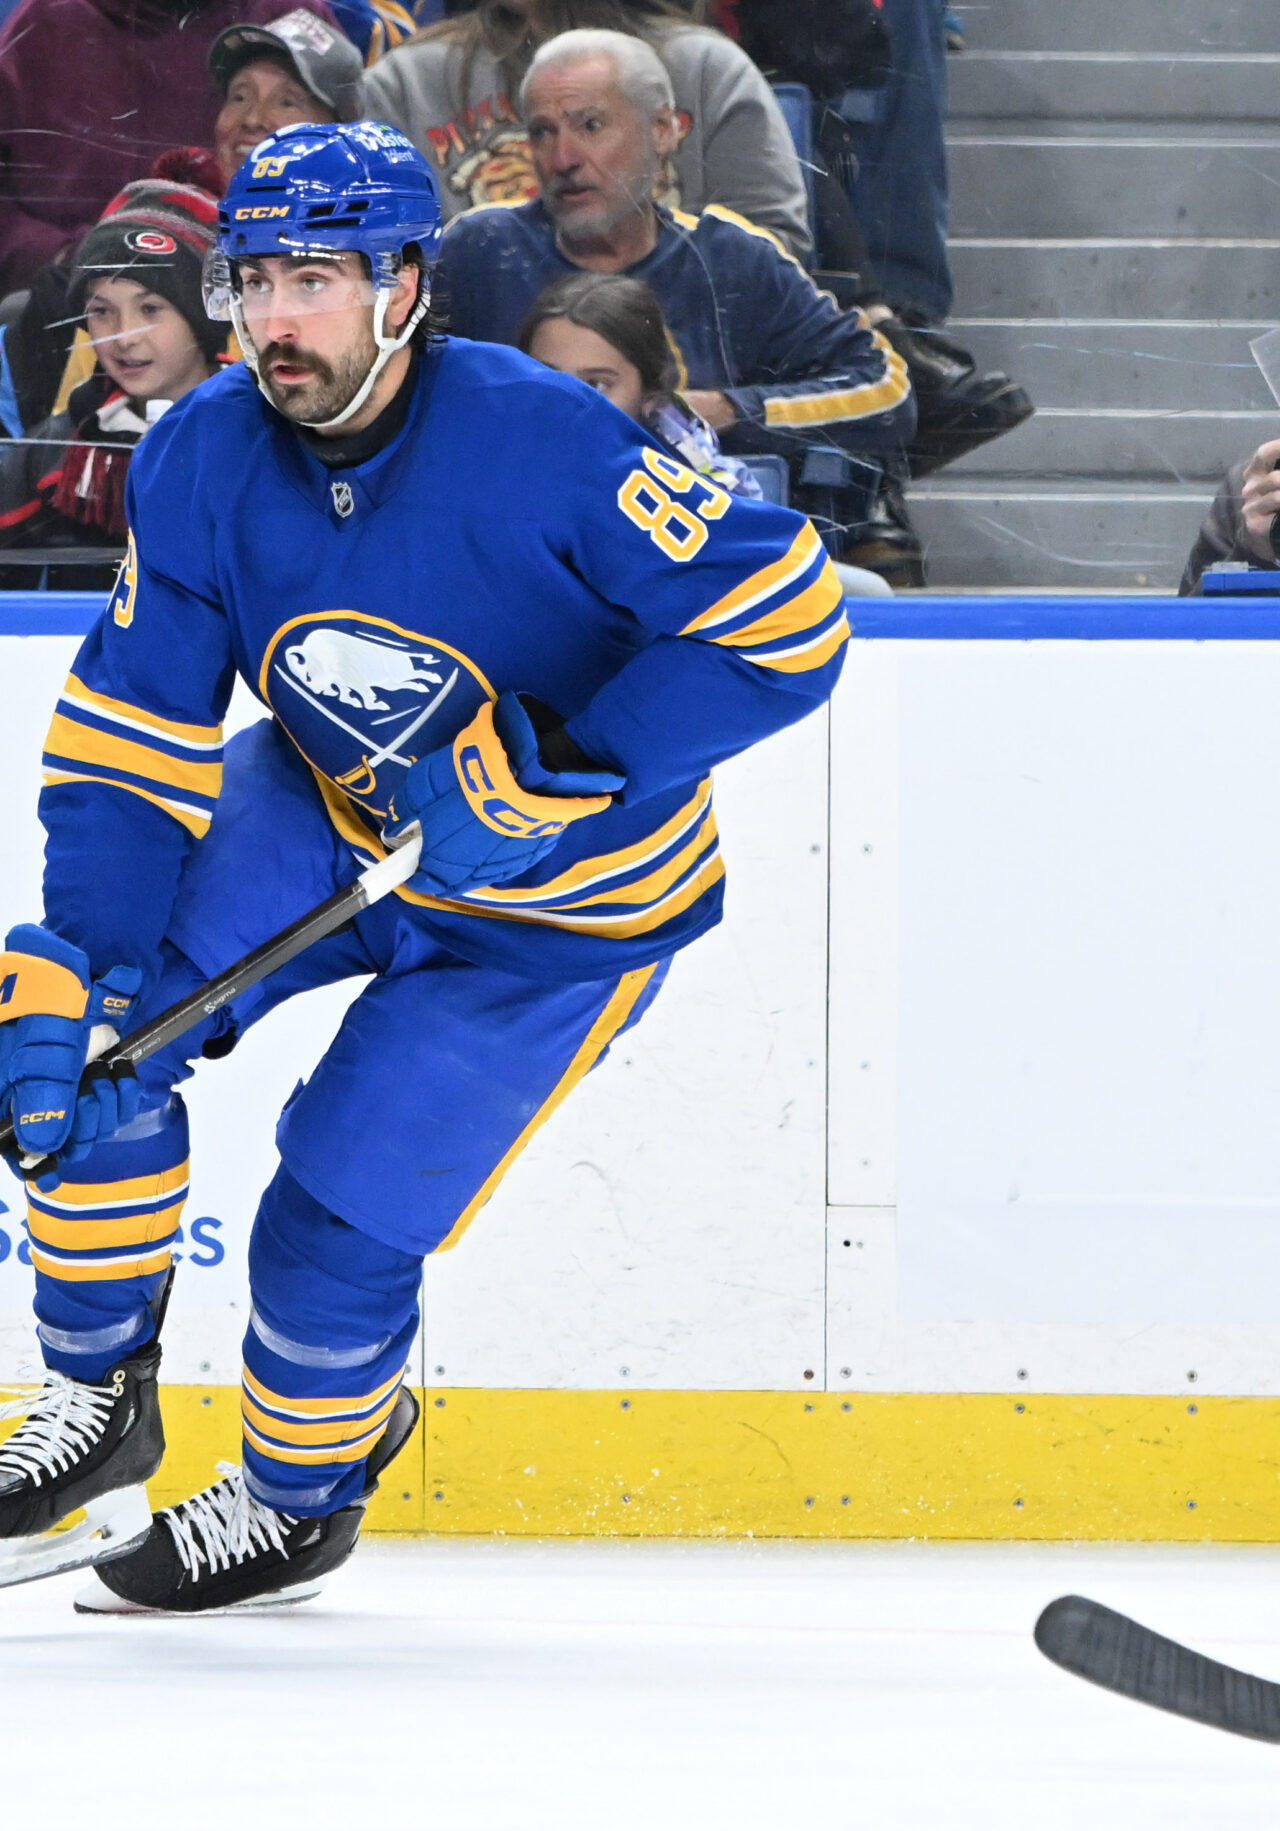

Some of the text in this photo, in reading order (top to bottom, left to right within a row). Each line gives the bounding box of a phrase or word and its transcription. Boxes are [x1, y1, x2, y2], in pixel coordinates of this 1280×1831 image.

[252, 155, 291, 179] 89
[235, 205, 290, 220] CCM
[617, 446, 733, 562] 89
[20, 1109, 66, 1126] CCM
